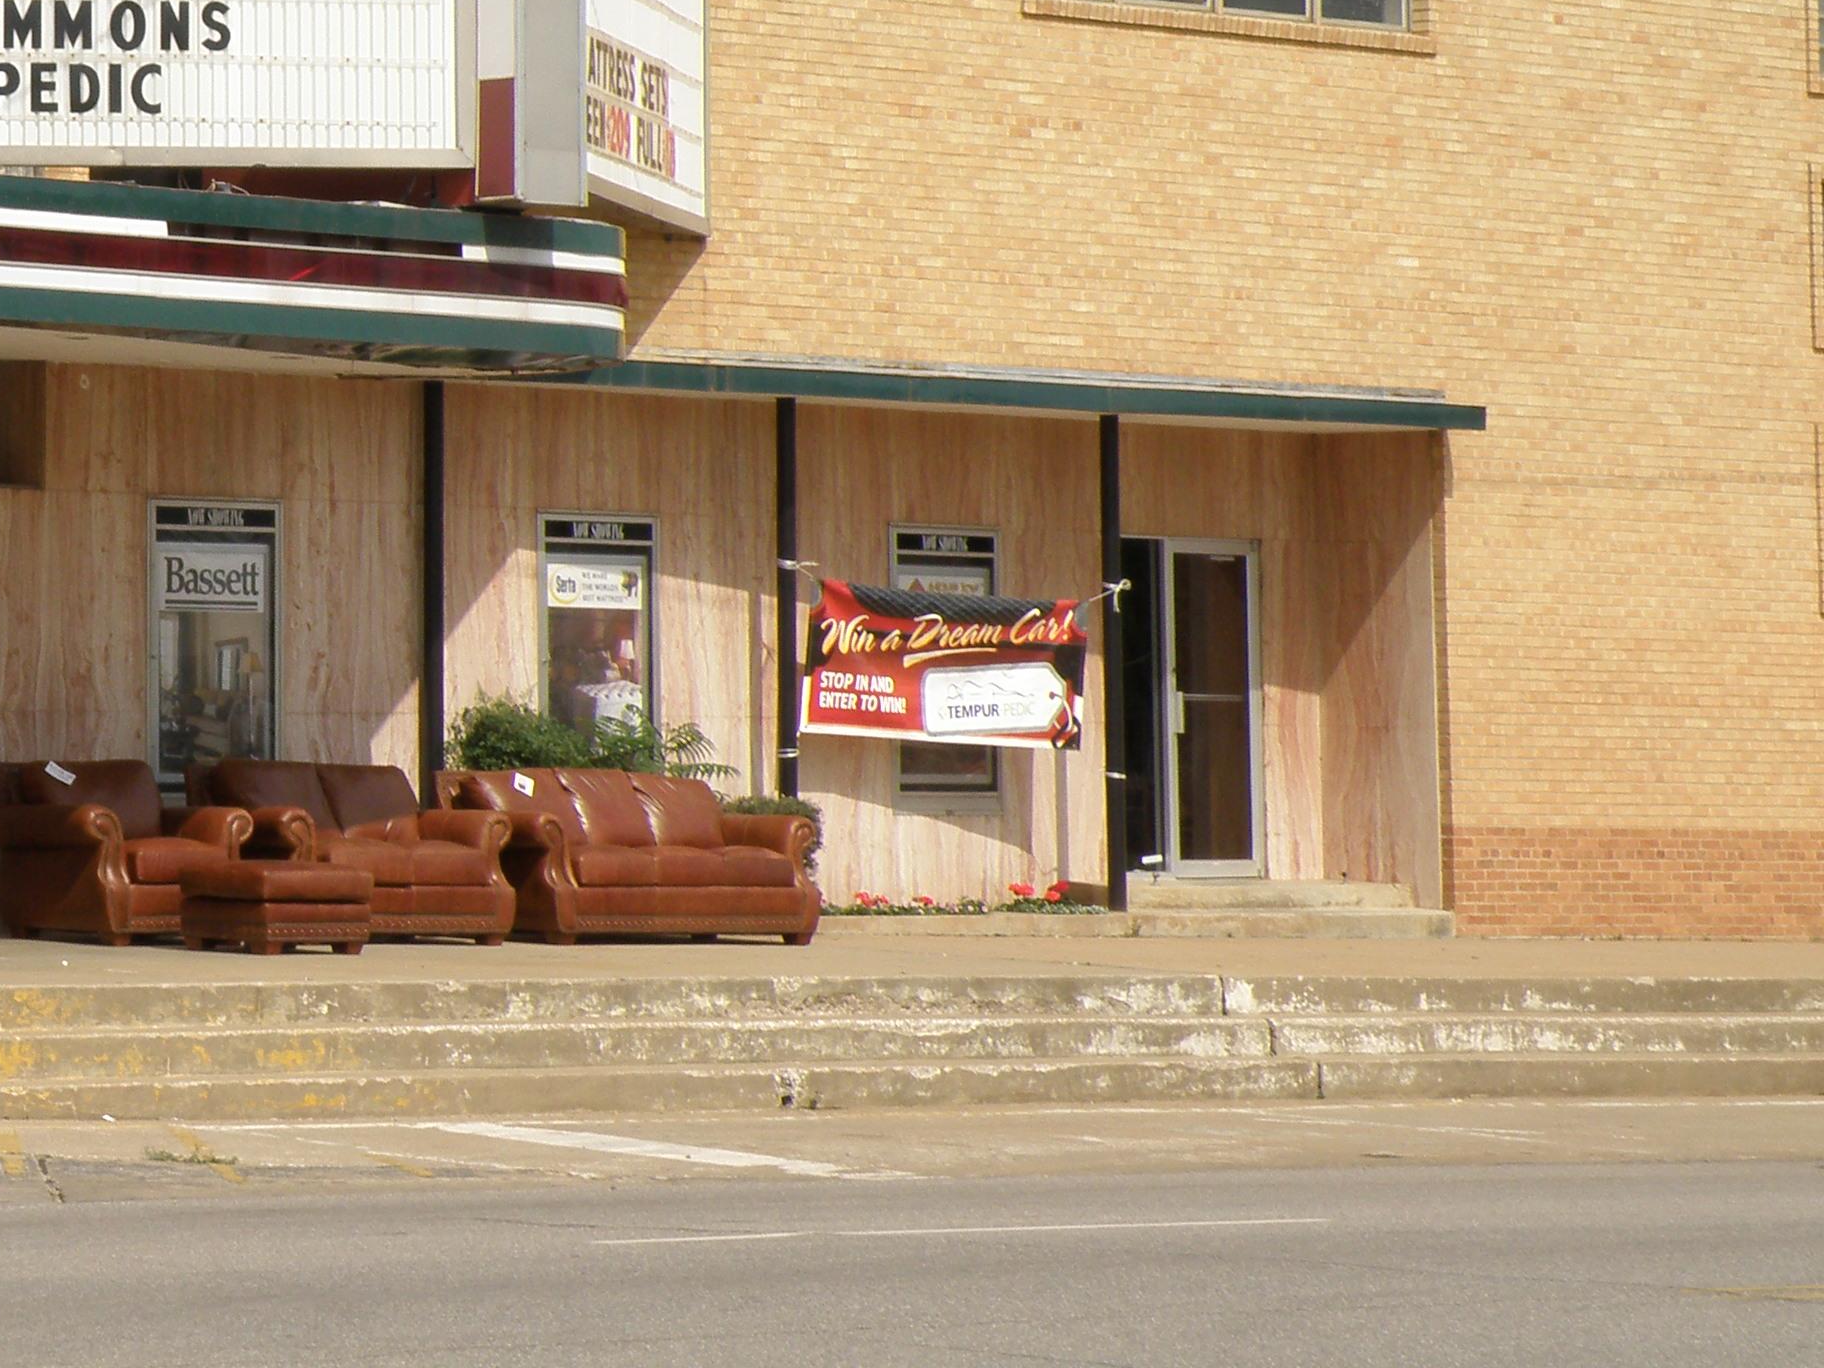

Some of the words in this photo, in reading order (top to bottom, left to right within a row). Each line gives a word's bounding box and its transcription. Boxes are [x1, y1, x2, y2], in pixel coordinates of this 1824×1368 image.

[641, 61, 668, 118] SETS
[164, 556, 259, 595] Bassett
[556, 575, 576, 593] Serta
[820, 614, 876, 655] Win
[880, 629, 904, 652] a
[907, 613, 1003, 650] Dream
[1009, 608, 1074, 646] Car!
[820, 671, 854, 689] STOP
[855, 674, 869, 692] IN
[870, 676, 894, 694] AND
[819, 691, 857, 710] ENTER
[861, 695, 878, 711] TO
[879, 695, 907, 714] WIN!
[947, 704, 999, 719] TEMPUR
